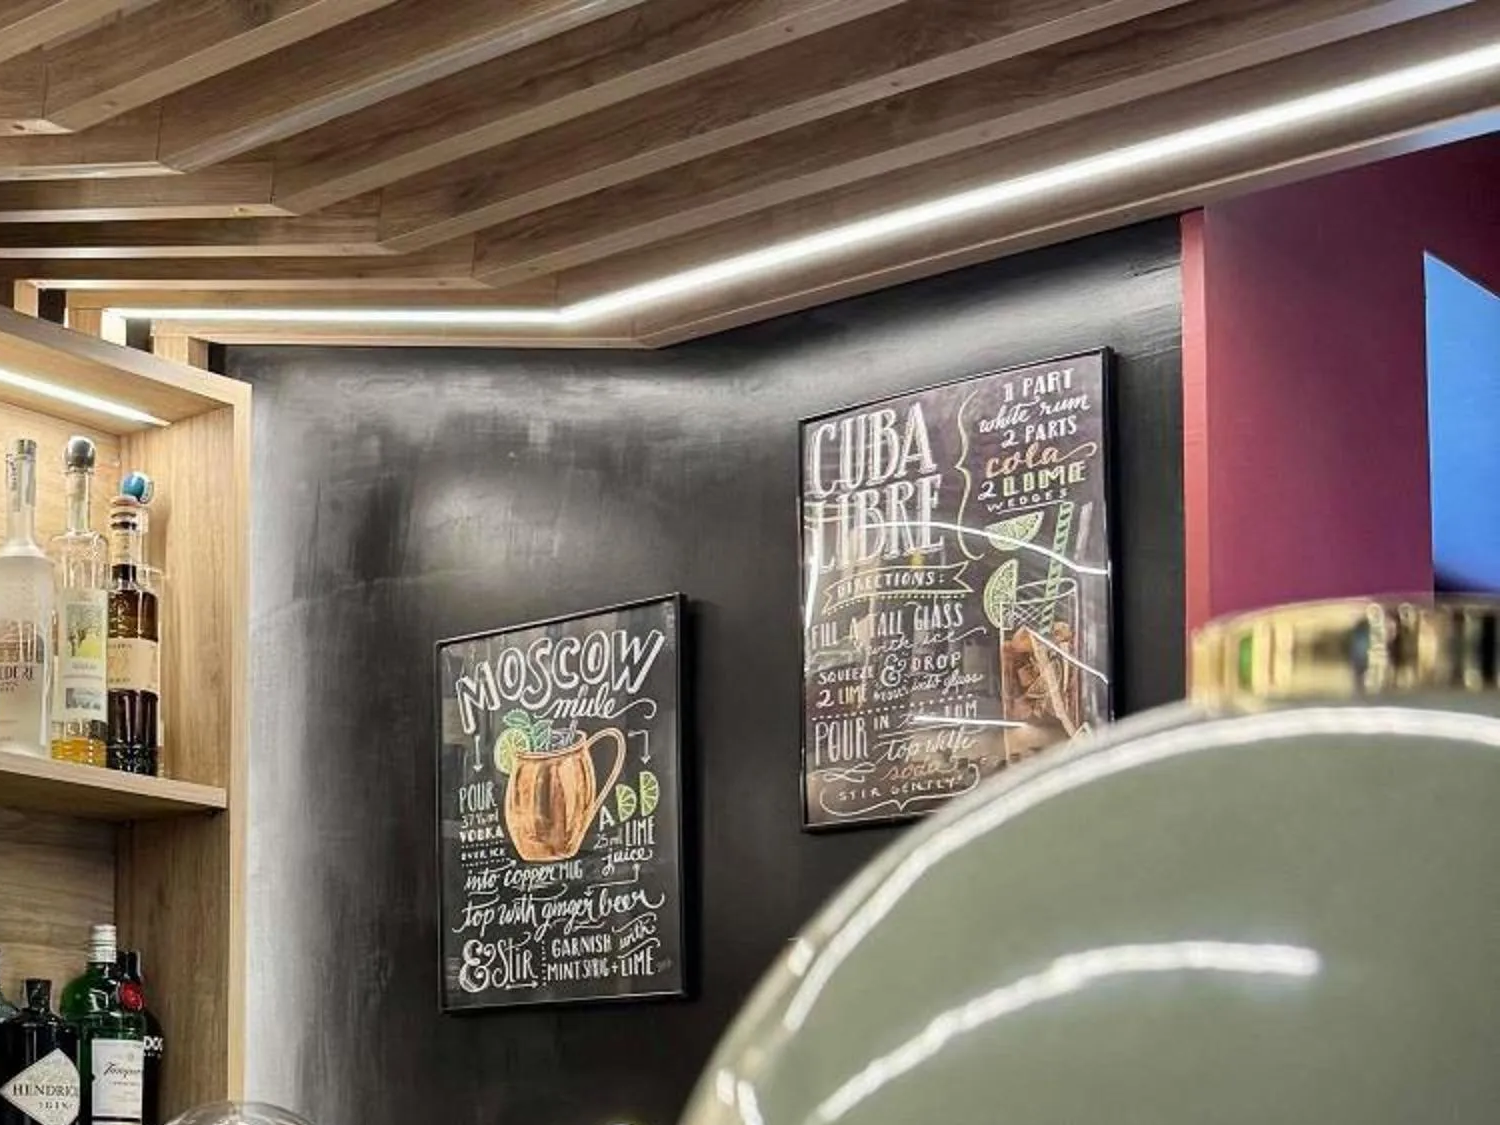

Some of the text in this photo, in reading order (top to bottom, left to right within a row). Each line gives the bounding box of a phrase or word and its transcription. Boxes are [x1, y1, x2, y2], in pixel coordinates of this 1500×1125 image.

[1022, 368, 1075, 398] PART
[978, 393, 1091, 434] white rum
[1000, 415, 1077, 449] 2 PARTS
[807, 401, 937, 499] CUBA
[986, 441, 1084, 479] cola
[978, 459, 1088, 501] 2 LIME
[987, 489, 1068, 513] WEDGES
[805, 474, 945, 575] LIBRE
[909, 602, 964, 631] GLASS
[911, 651, 962, 672] DROP
[456, 629, 666, 736] MOSCOW
[816, 689, 835, 709] 2
[538, 683, 640, 720] mule
[814, 717, 869, 766] POUR
[873, 714, 891, 731] IN
[459, 781, 499, 813] POUR
[459, 825, 505, 843] VODKA
[625, 815, 656, 847] LIME
[464, 867, 501, 892] into
[554, 860, 583, 881] MUG
[601, 848, 653, 877] juice
[453, 887, 665, 941] top with ginger beer
[551, 934, 612, 959] GARNISH
[548, 962, 581, 982] MINT
[621, 946, 656, 978] LIME
